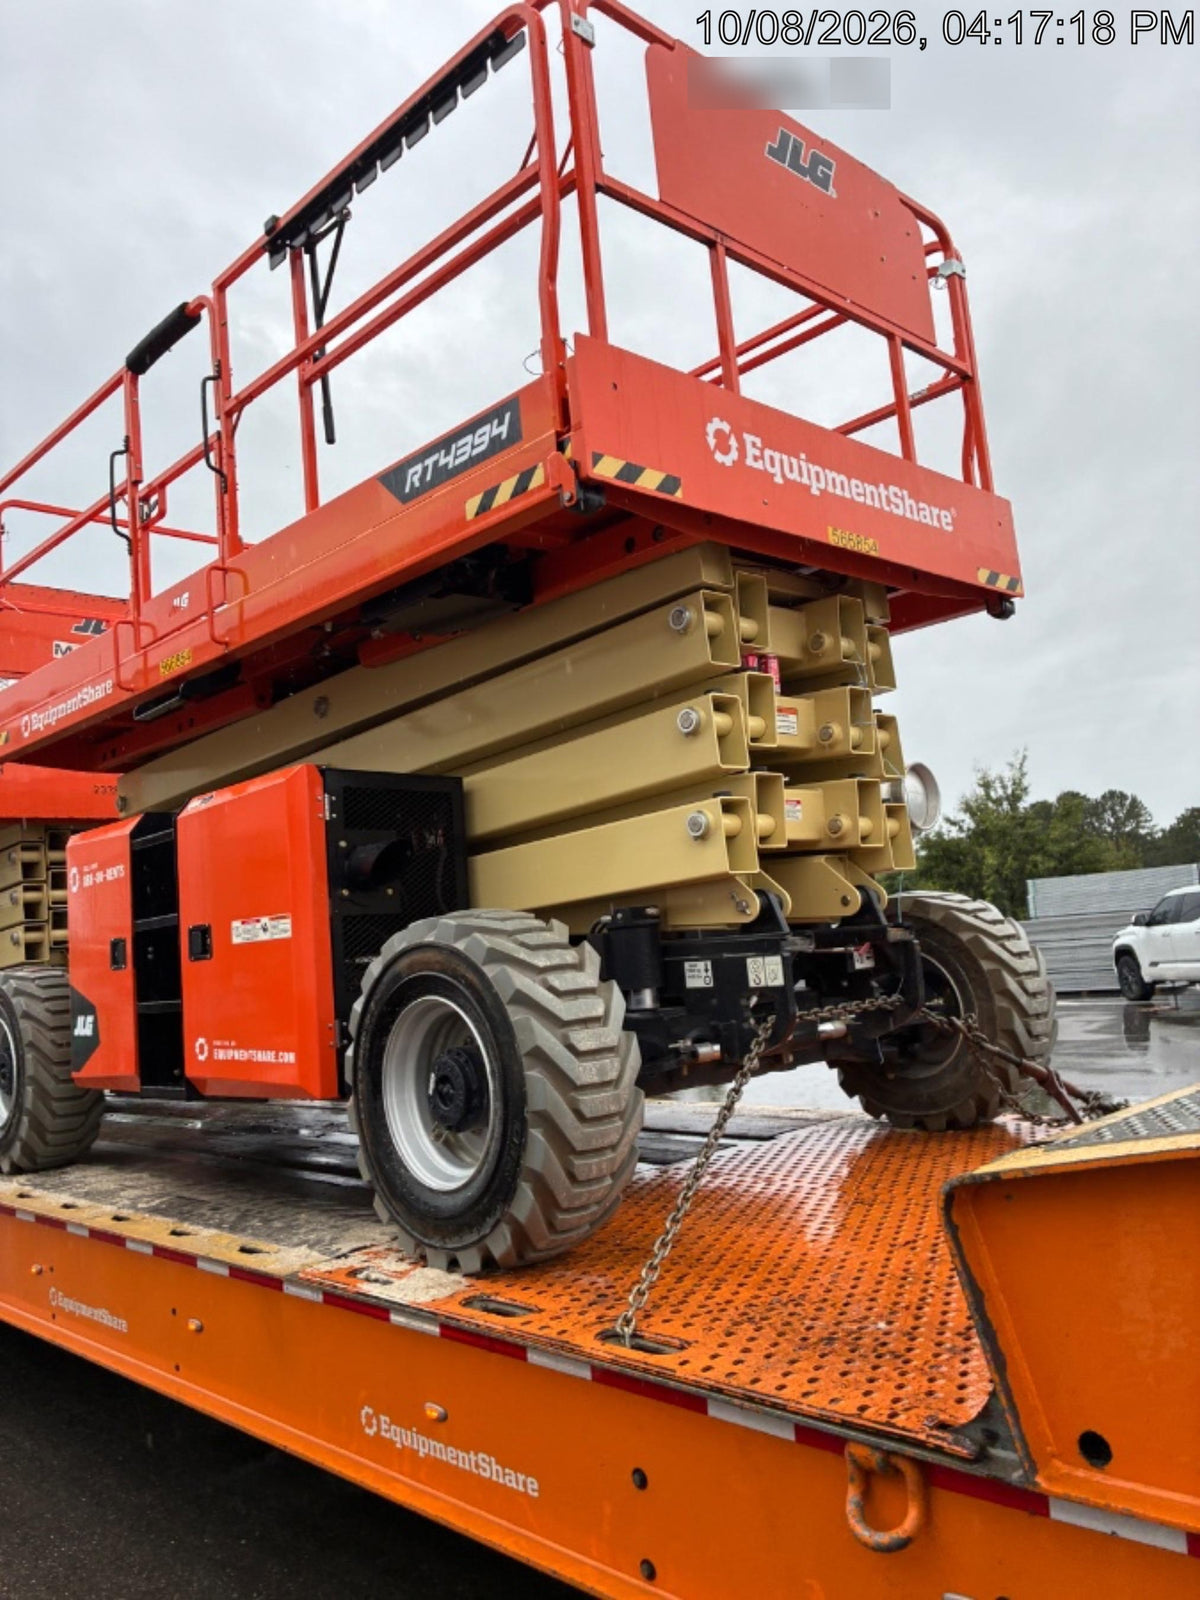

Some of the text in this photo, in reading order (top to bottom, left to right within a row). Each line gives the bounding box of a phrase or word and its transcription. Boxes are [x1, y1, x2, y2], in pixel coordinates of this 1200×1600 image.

[764, 126, 837, 197] JLG
[404, 411, 511, 494] RT4394
[742, 432, 954, 532] EquipmentShare
[70, 618, 107, 637] JL
[31, 679, 113, 732] EquipmentShare
[73, 1014, 95, 1037] JLG
[58, 1290, 128, 1333] EquipmentShare
[379, 1414, 540, 1499] EquipmentShare
